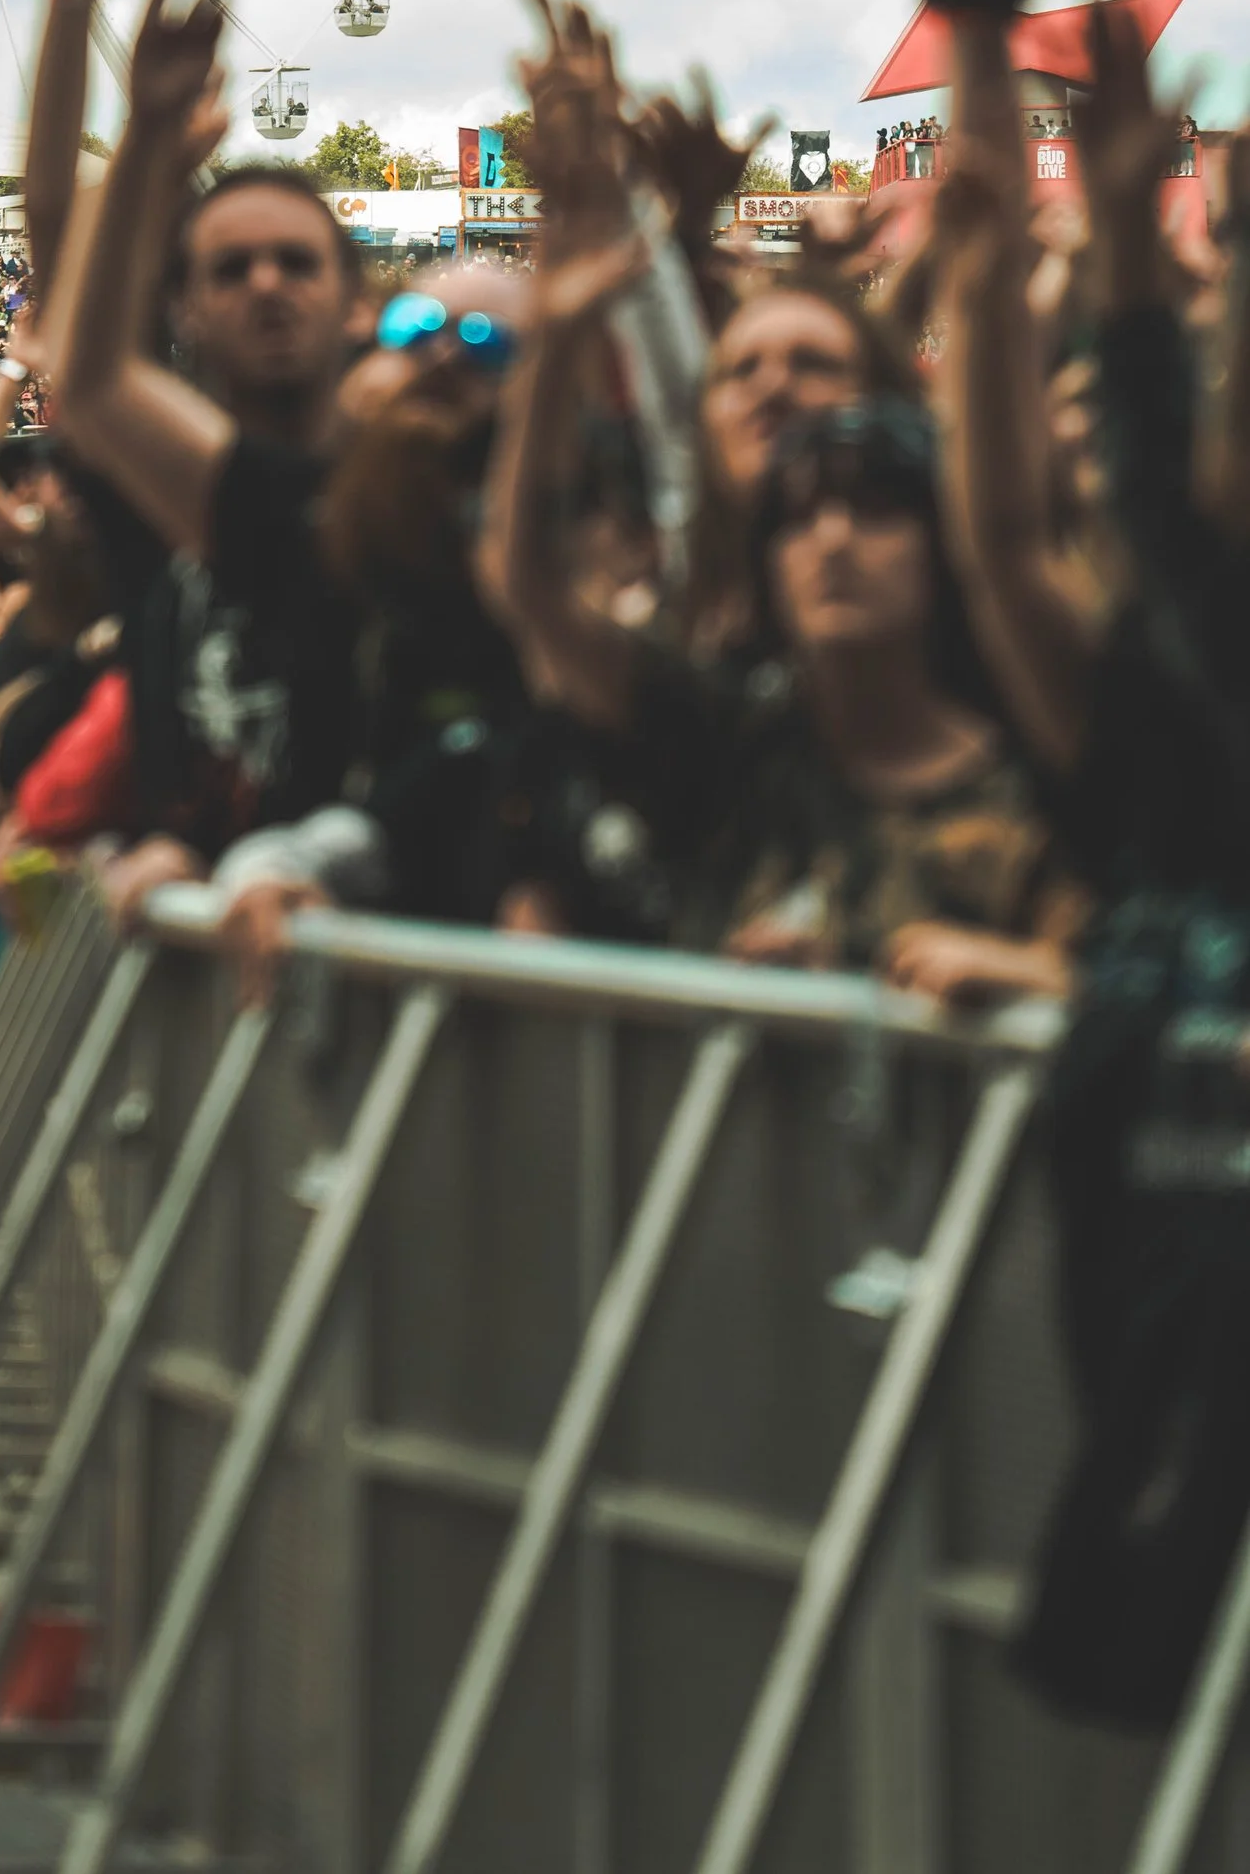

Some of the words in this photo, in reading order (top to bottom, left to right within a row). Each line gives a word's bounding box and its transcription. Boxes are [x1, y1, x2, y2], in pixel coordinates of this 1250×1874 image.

[1037, 150, 1066, 165] BUD
[1037, 164, 1066, 179] LIVE
[467, 195, 524, 216] THE
